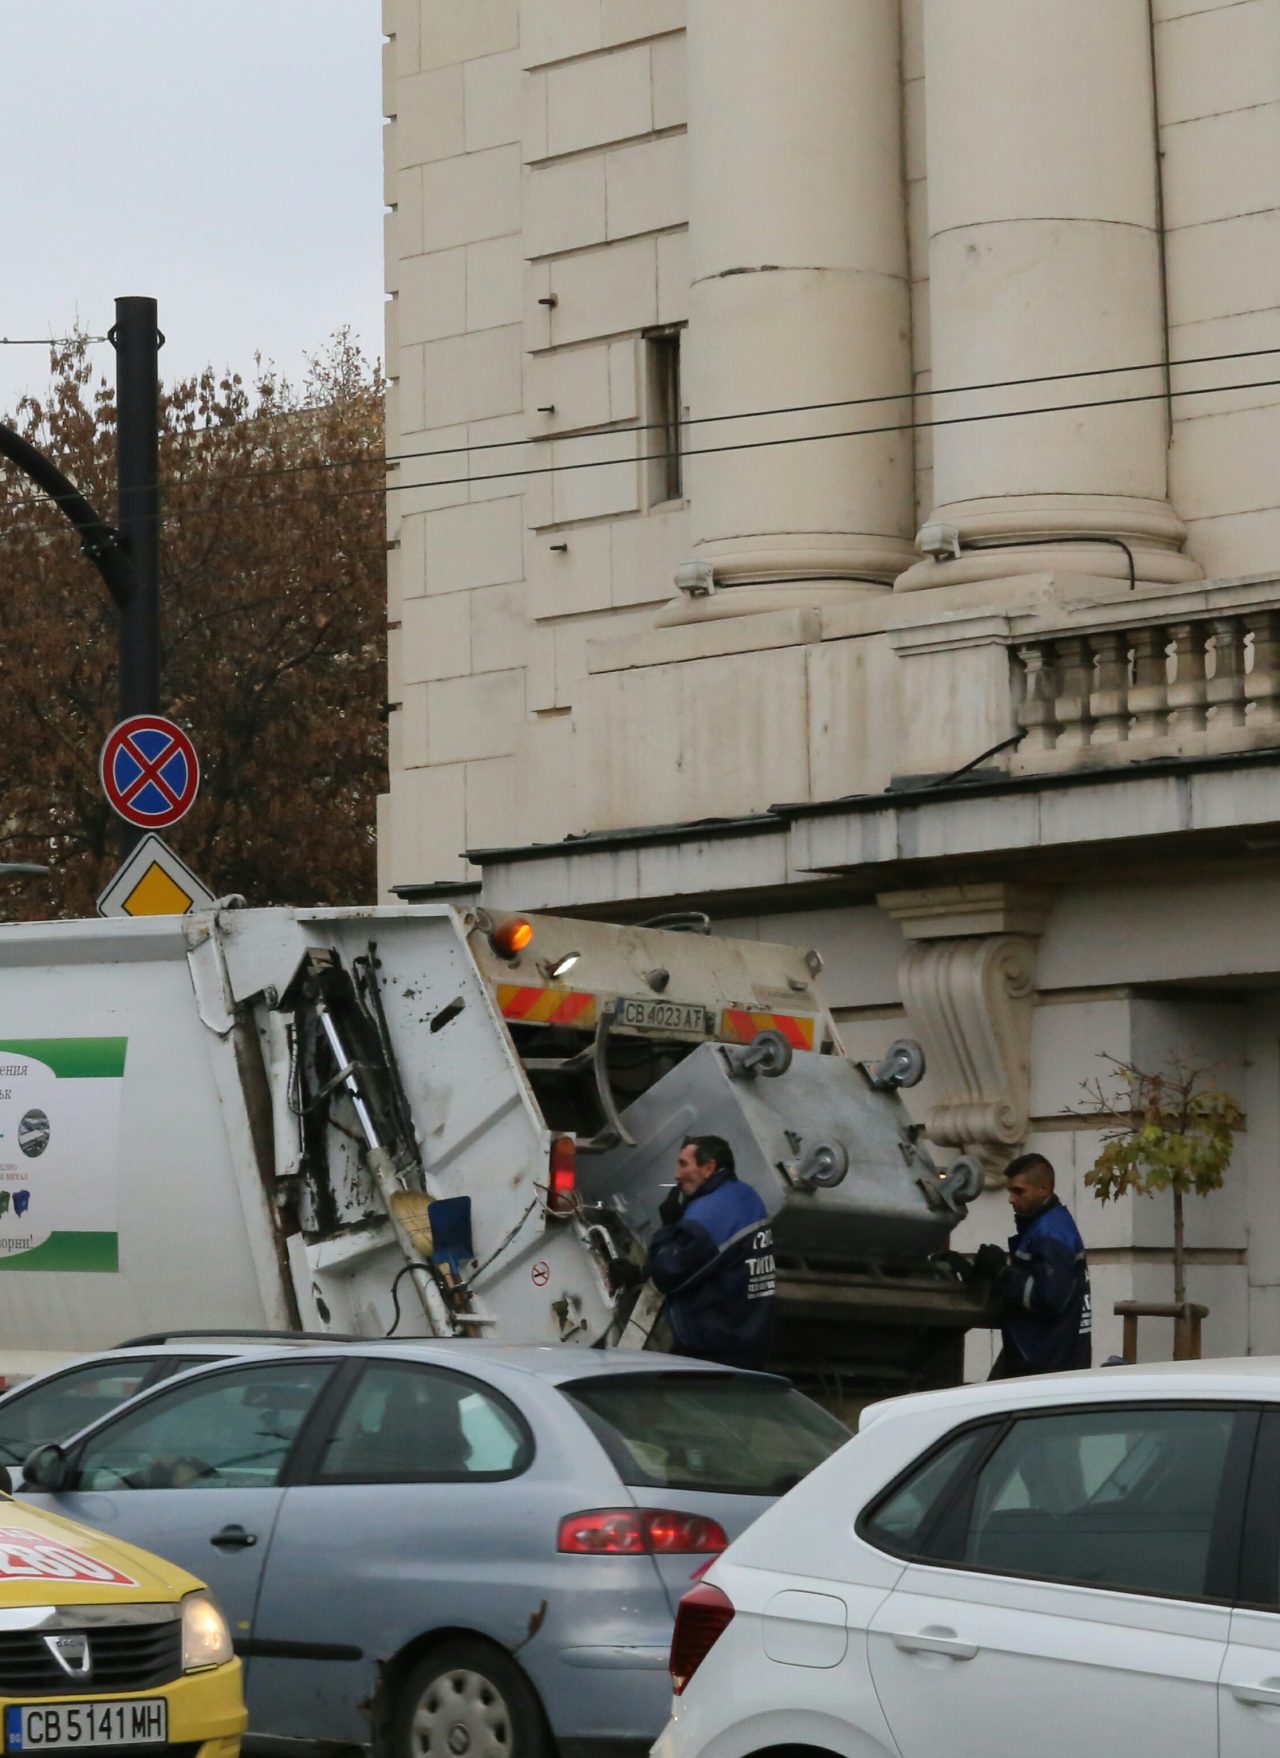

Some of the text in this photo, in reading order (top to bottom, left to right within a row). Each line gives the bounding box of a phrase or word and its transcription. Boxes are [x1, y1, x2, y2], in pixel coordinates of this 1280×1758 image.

[647, 1005, 682, 1026] 4023
[27, 1705, 161, 1743] CB 5141 MH
